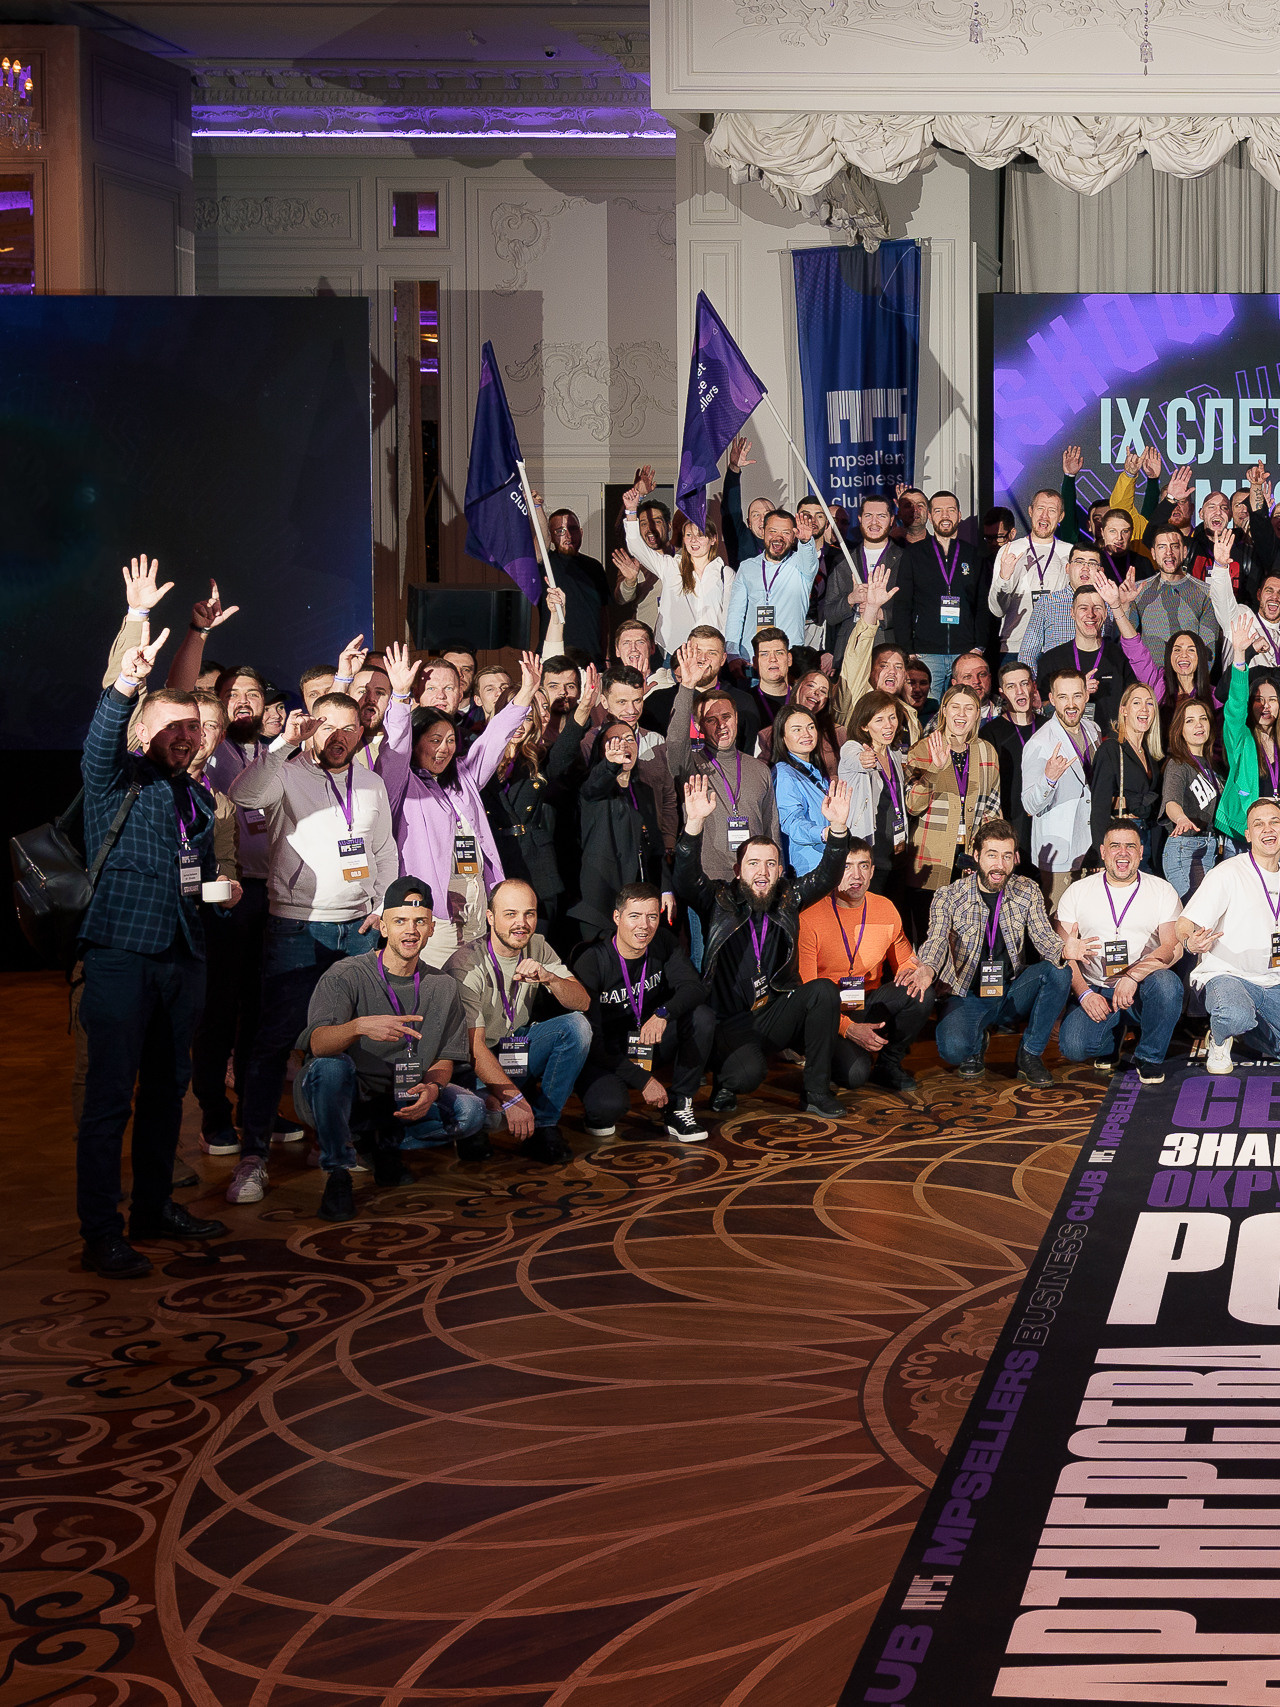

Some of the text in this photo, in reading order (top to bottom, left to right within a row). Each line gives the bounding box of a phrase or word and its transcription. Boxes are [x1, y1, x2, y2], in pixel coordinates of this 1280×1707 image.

[829, 450, 905, 472] mpsellers
[830, 471, 904, 488] business
[863, 1623, 934, 1707] UB
[921, 1349, 1040, 1566] MPSELLERS
[1012, 1223, 1089, 1347] BUSINESS
[1066, 1169, 1109, 1221] CLUB
[1095, 1069, 1143, 1147] MPSELLER
